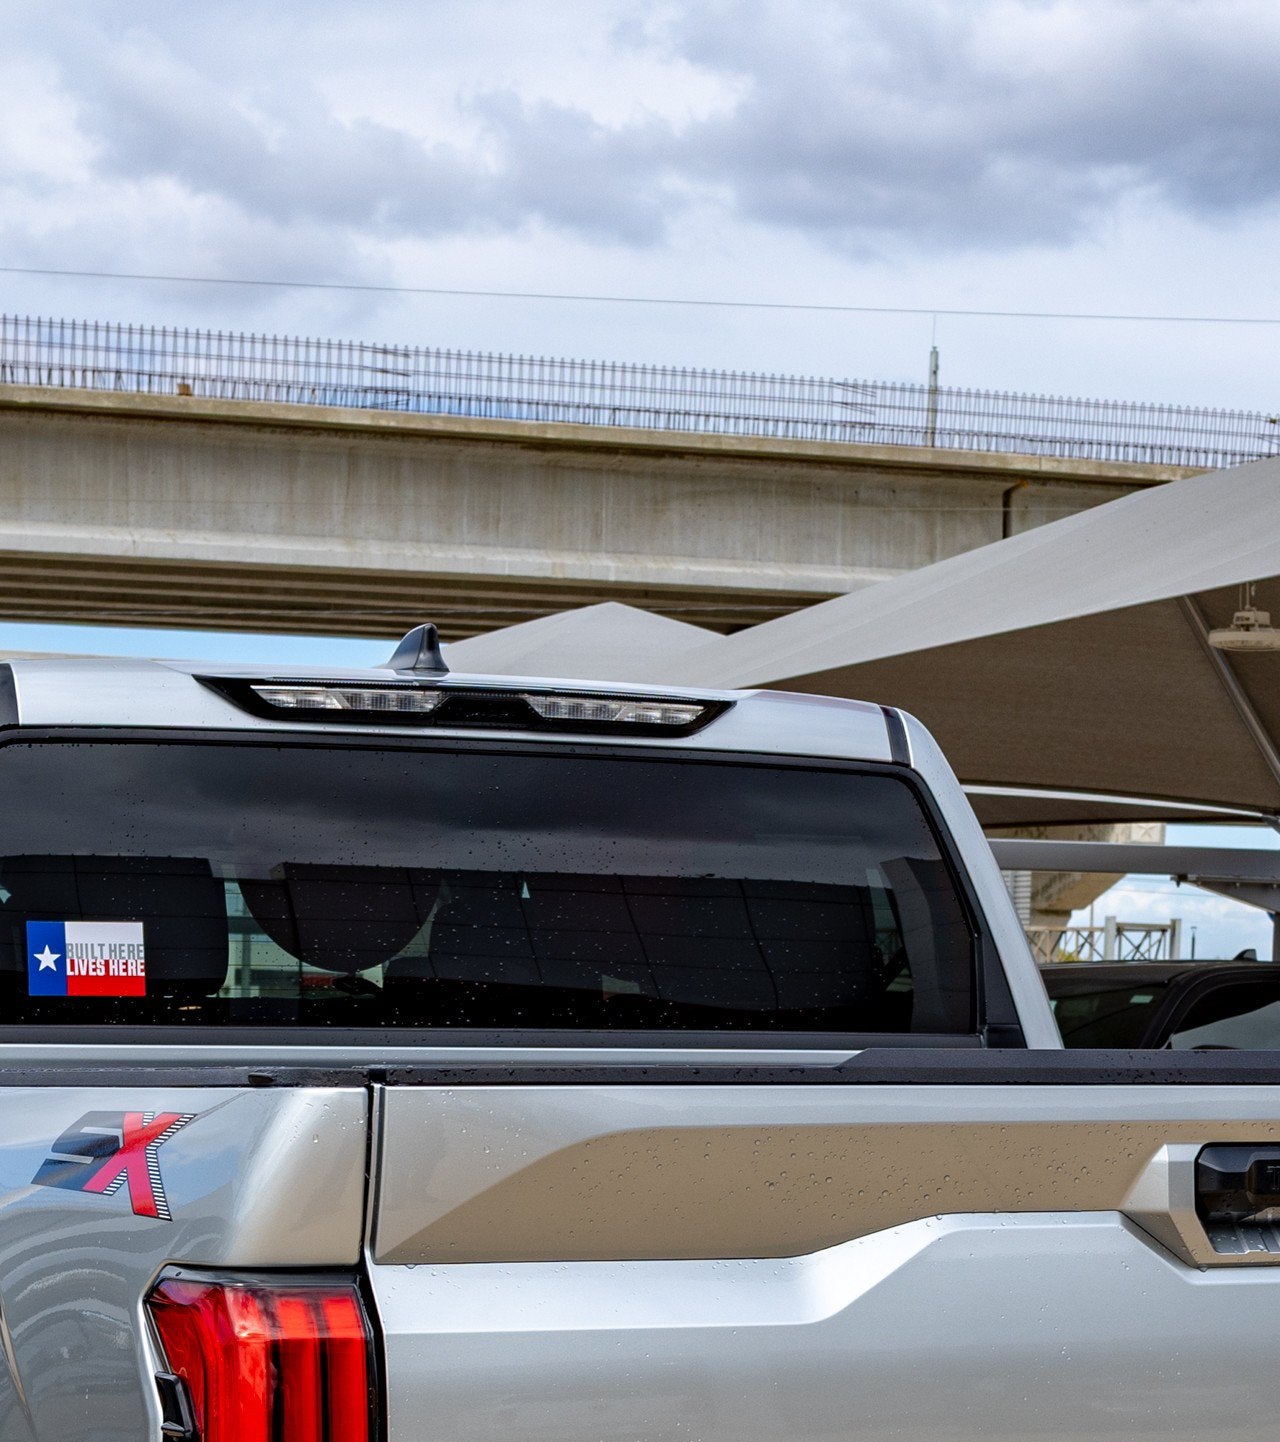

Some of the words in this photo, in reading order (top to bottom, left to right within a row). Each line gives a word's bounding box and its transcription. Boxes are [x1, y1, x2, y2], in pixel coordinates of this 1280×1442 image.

[66, 943, 106, 960] BUILT
[108, 943, 144, 960] HERE
[66, 959, 106, 976] LIVES
[108, 959, 146, 977] HERE
